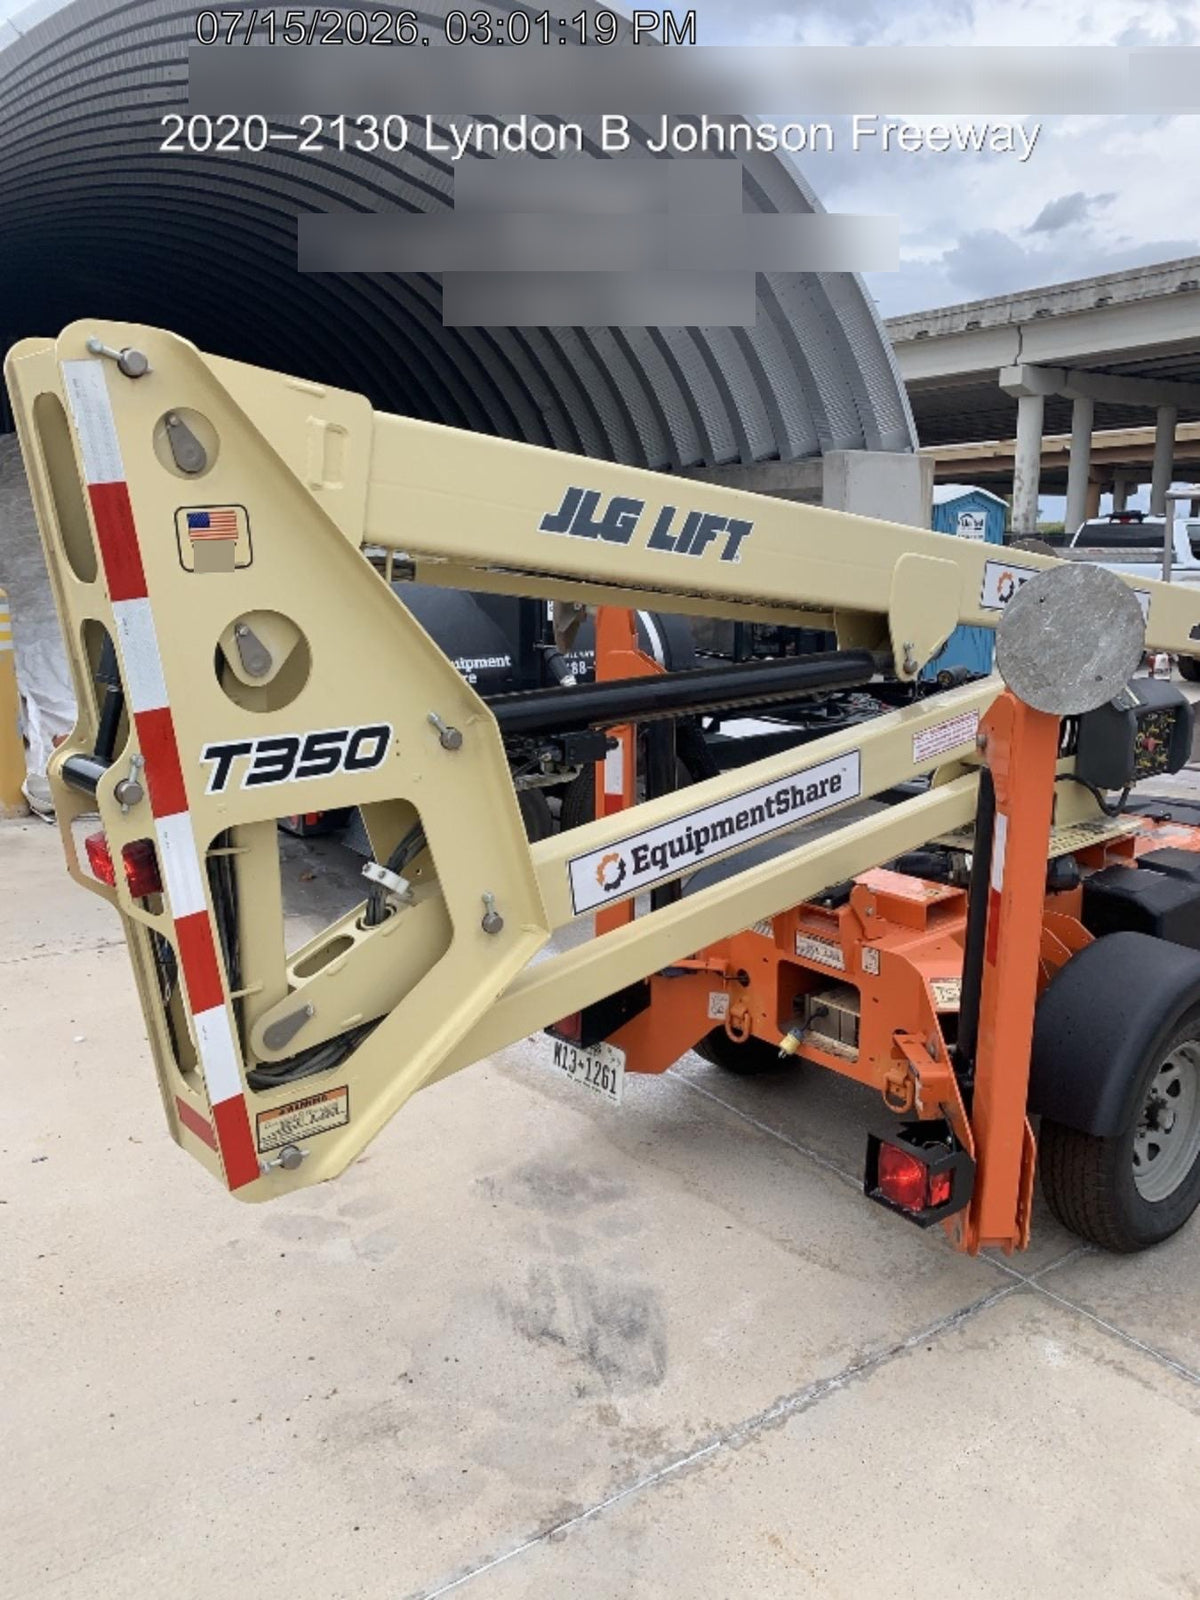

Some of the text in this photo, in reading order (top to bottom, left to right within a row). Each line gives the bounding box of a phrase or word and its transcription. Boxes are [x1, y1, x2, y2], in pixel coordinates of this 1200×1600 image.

[538, 486, 754, 562] JLG LIFT
[201, 723, 393, 793] T350
[632, 773, 843, 876] EquipmentShare
